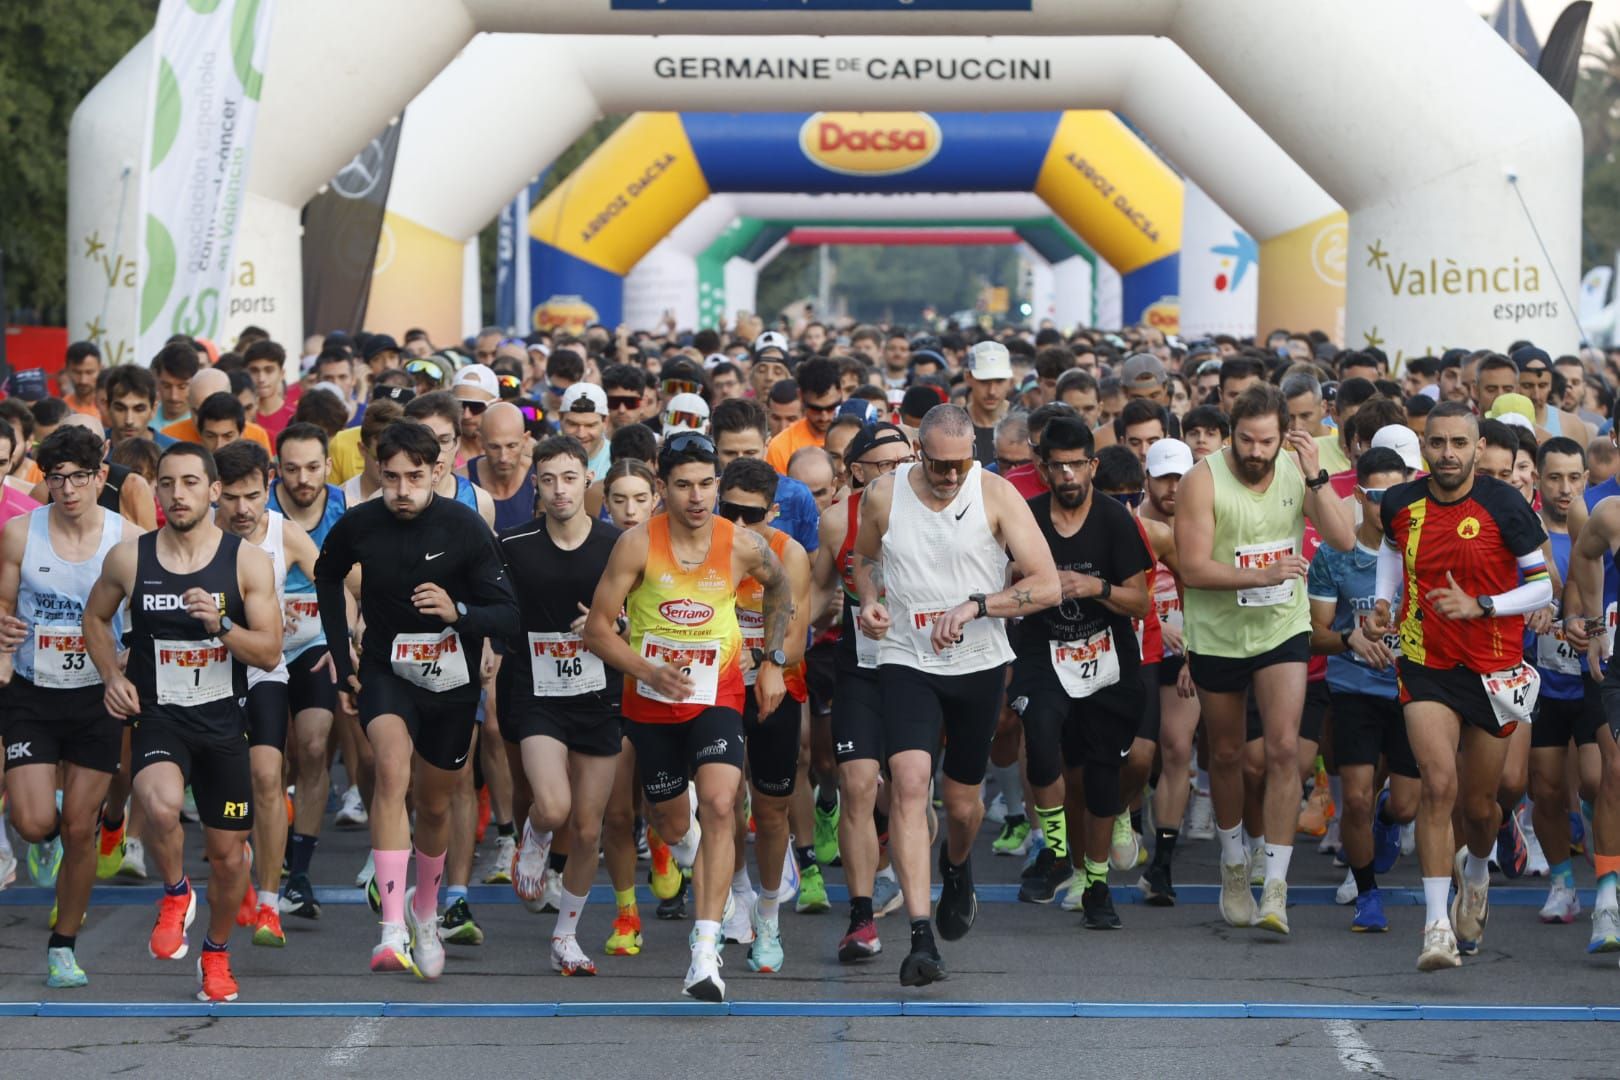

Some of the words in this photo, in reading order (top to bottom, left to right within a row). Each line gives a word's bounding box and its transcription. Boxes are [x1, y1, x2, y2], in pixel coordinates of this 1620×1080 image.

[654, 57, 830, 79] GERMAINE
[836, 58, 861, 71] DE
[867, 58, 1052, 80] CAPUCCINI
[819, 121, 927, 151] Dacsa
[582, 194, 629, 242] ARROZ
[626, 152, 676, 197] DACSA
[1065, 152, 1115, 198] ARROZ
[1113, 195, 1159, 243] DACSA
[1386, 257, 1541, 296] València
[230, 296, 275, 316] ports
[1493, 300, 1559, 323] esports
[35, 597, 72, 610] VOLTA
[665, 605, 711, 619] Serrano
[62, 653, 86, 670] 33
[421, 660, 442, 677] 74
[555, 656, 582, 677] 146
[1080, 658, 1098, 679] 27
[193, 668, 200, 686] 1
[223, 801, 244, 817] R1
